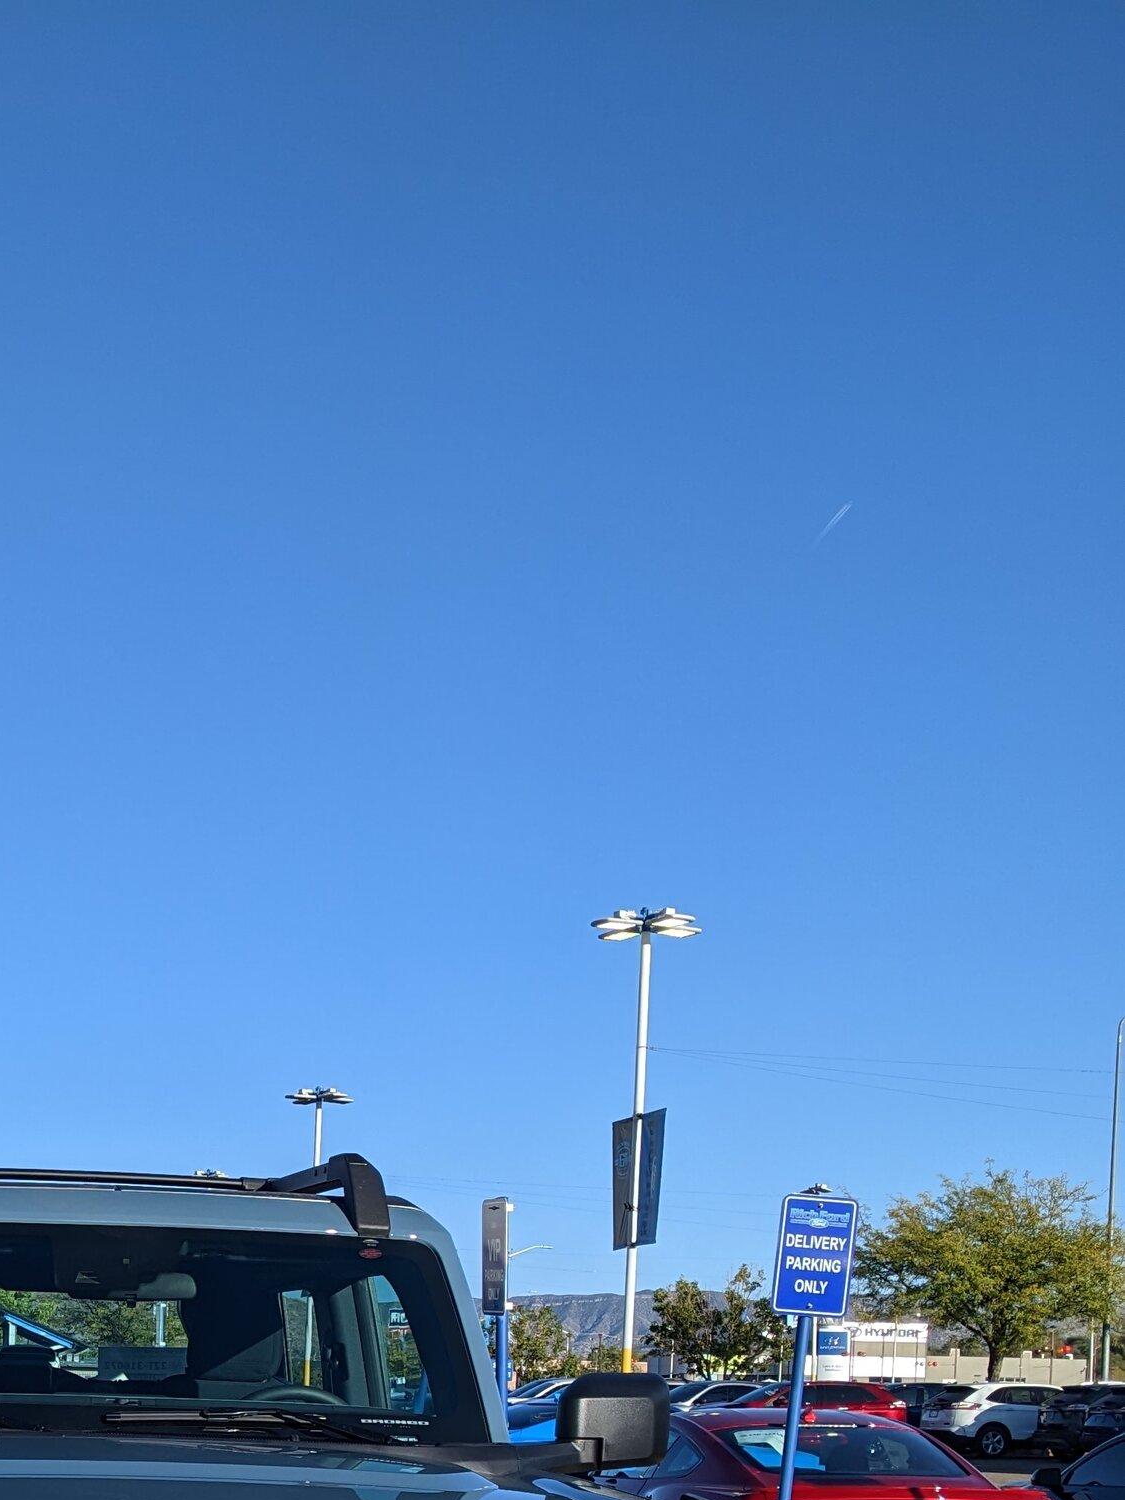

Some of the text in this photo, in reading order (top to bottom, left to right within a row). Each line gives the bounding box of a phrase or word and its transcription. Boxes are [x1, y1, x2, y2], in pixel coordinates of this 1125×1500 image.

[789, 1208, 850, 1222] Rich Ford
[487, 1238, 501, 1261] VIP
[785, 1233, 847, 1251] DELIVERY
[785, 1256, 841, 1273] PARKING
[484, 1269, 504, 1281] PARKING
[487, 1288, 500, 1300] ONLY
[795, 1279, 828, 1294] ONLY
